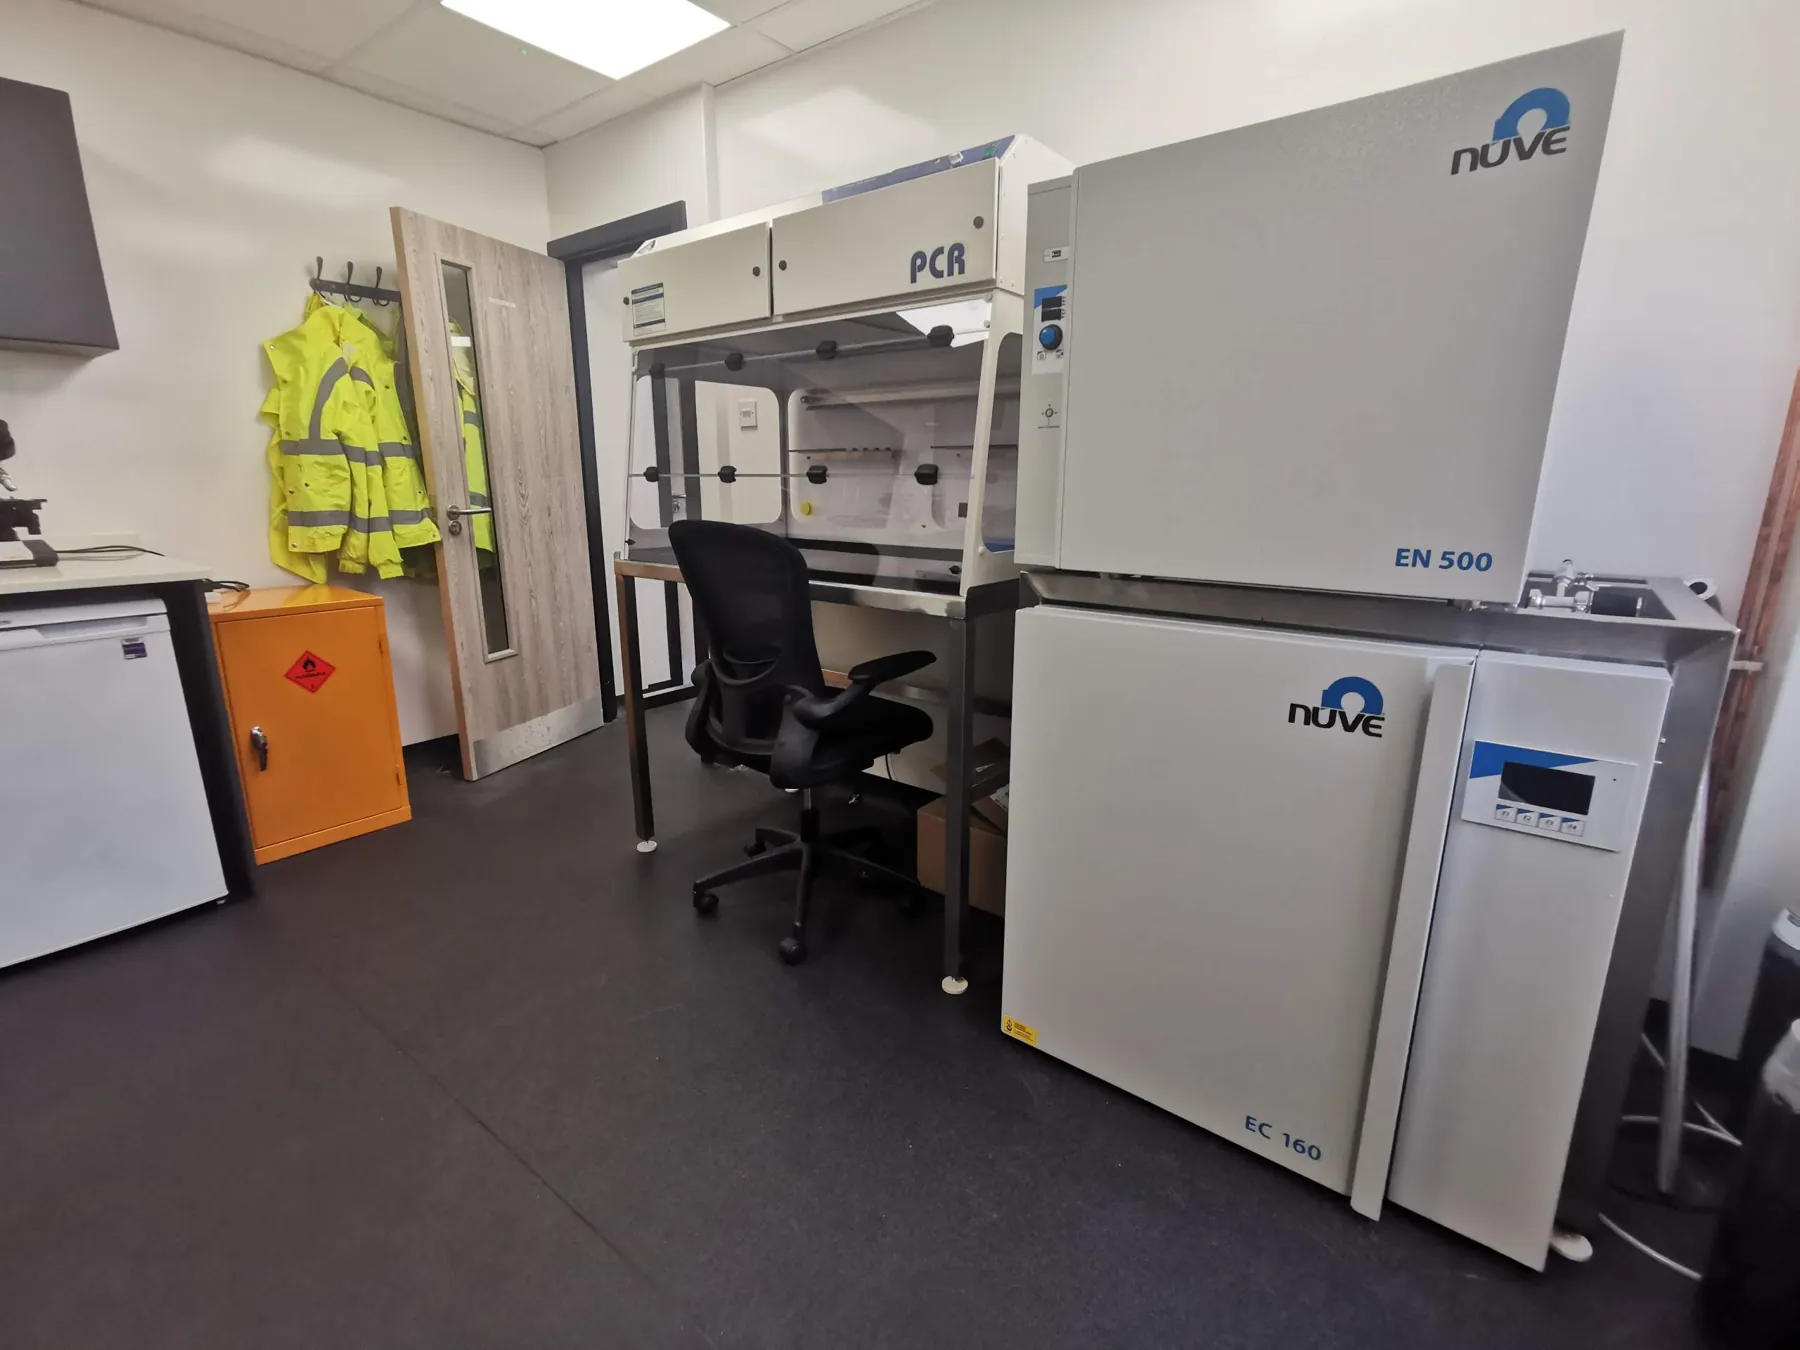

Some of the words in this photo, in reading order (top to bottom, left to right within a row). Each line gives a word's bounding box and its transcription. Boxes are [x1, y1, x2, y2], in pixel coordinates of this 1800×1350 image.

[910, 242, 965, 284] PCR
[1395, 548, 1432, 568] EN
[1439, 551, 1493, 572] 500
[1245, 1115, 1273, 1140] EC
[1282, 1132, 1321, 1161] 160
